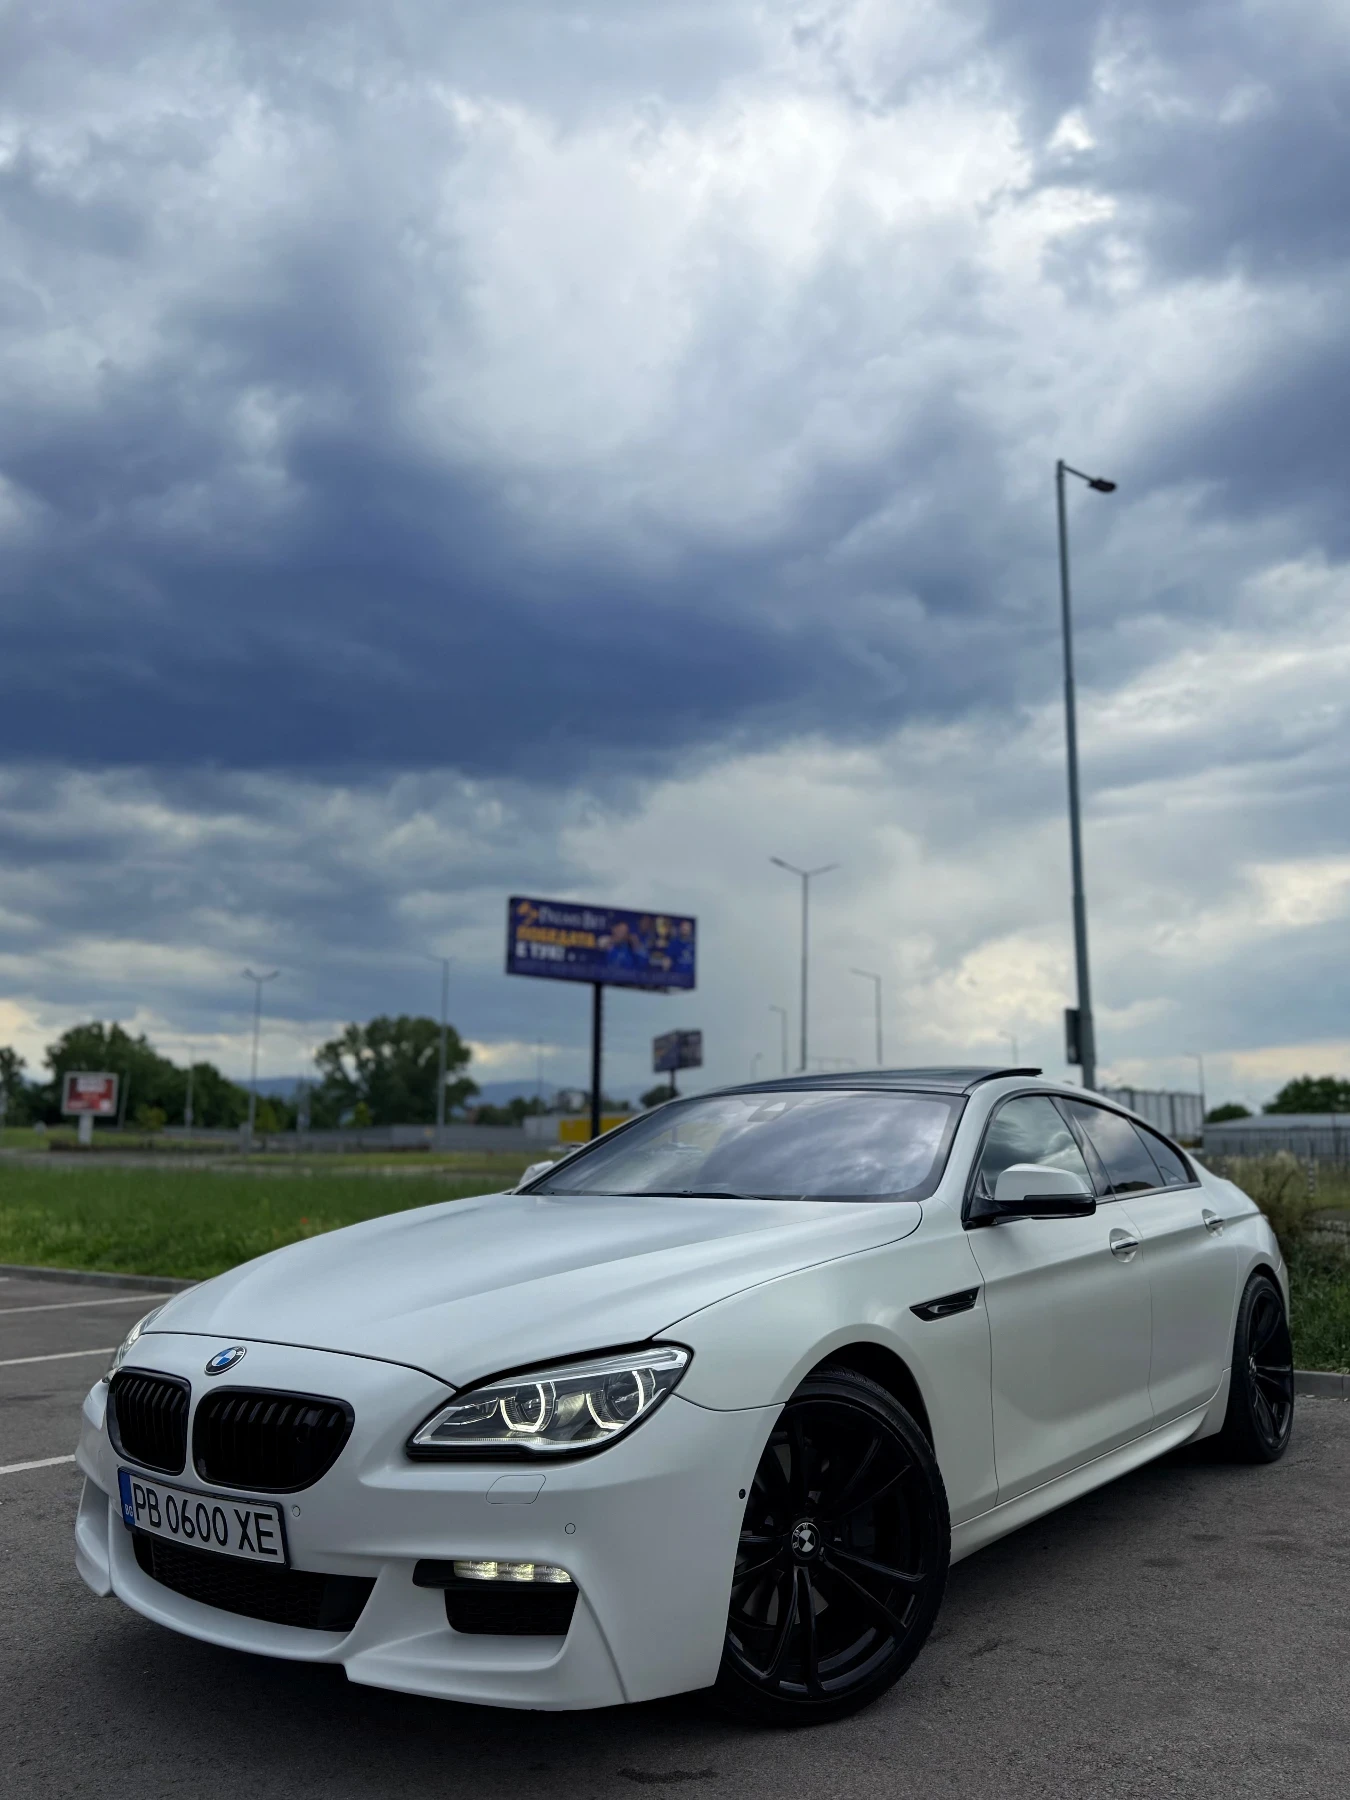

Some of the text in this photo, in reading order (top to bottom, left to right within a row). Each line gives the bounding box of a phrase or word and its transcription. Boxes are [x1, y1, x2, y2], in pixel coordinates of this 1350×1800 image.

[124, 1503, 134, 1517] BG
[133, 1482, 278, 1556] PB 0600 XE
